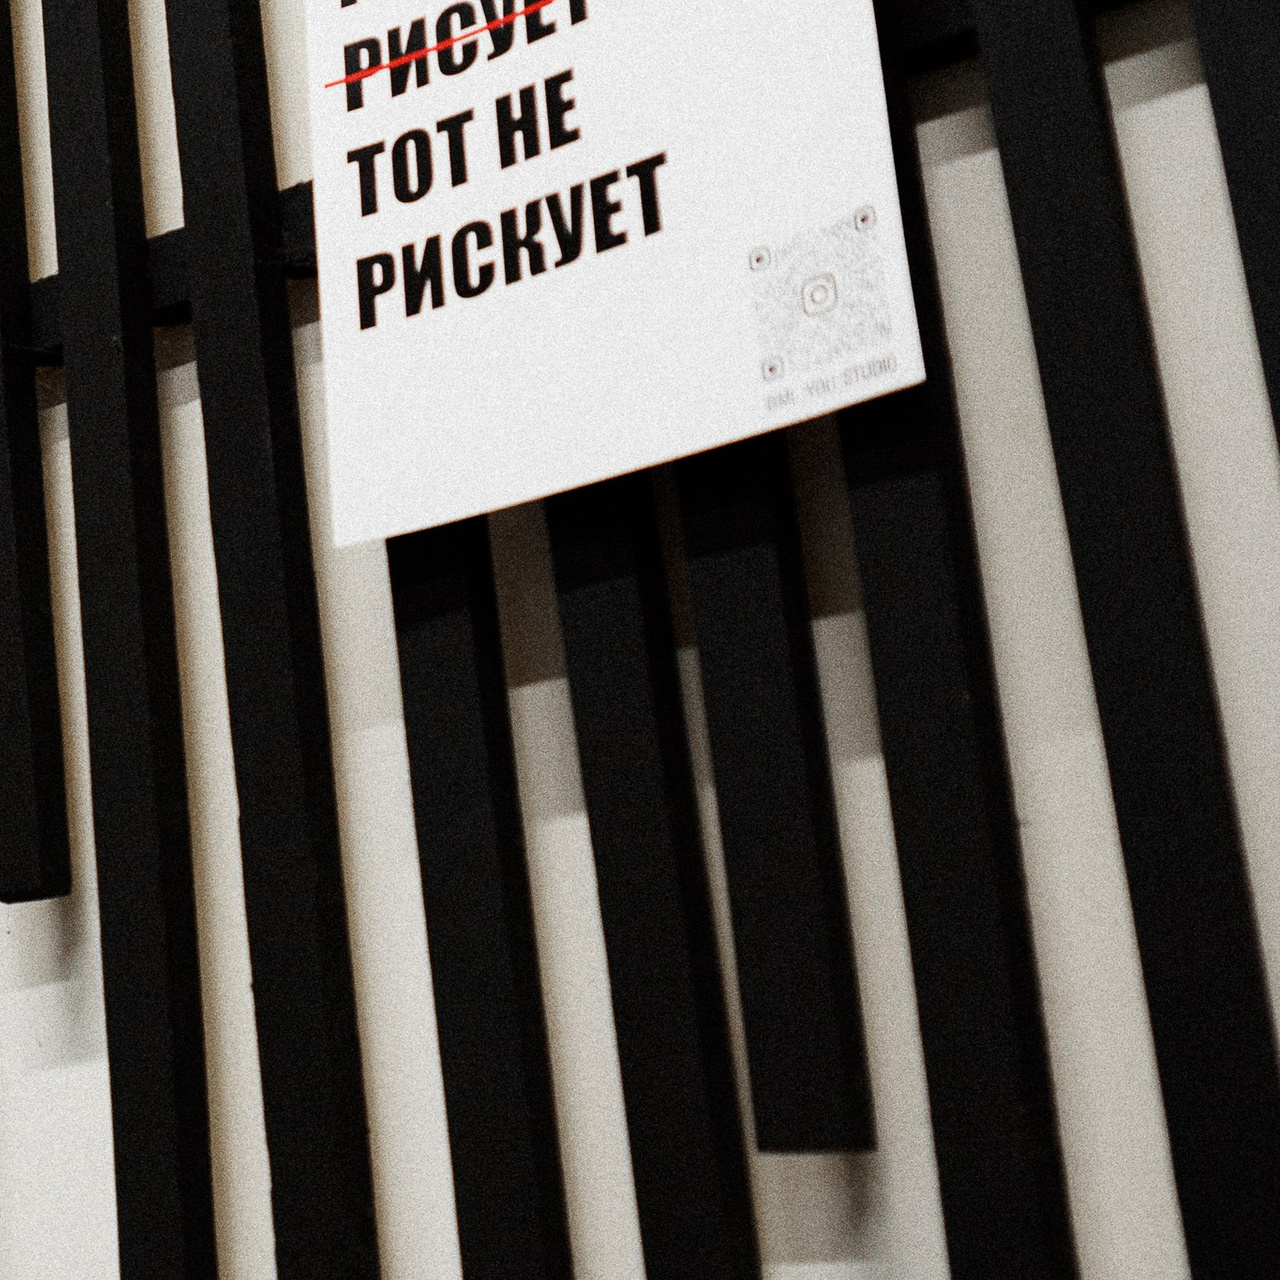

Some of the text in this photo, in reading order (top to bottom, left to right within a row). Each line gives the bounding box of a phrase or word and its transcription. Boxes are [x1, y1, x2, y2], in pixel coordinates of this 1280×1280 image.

[346, 68, 581, 218] ТОТ НЕ
[355, 152, 667, 331] РИСКУЕТ
